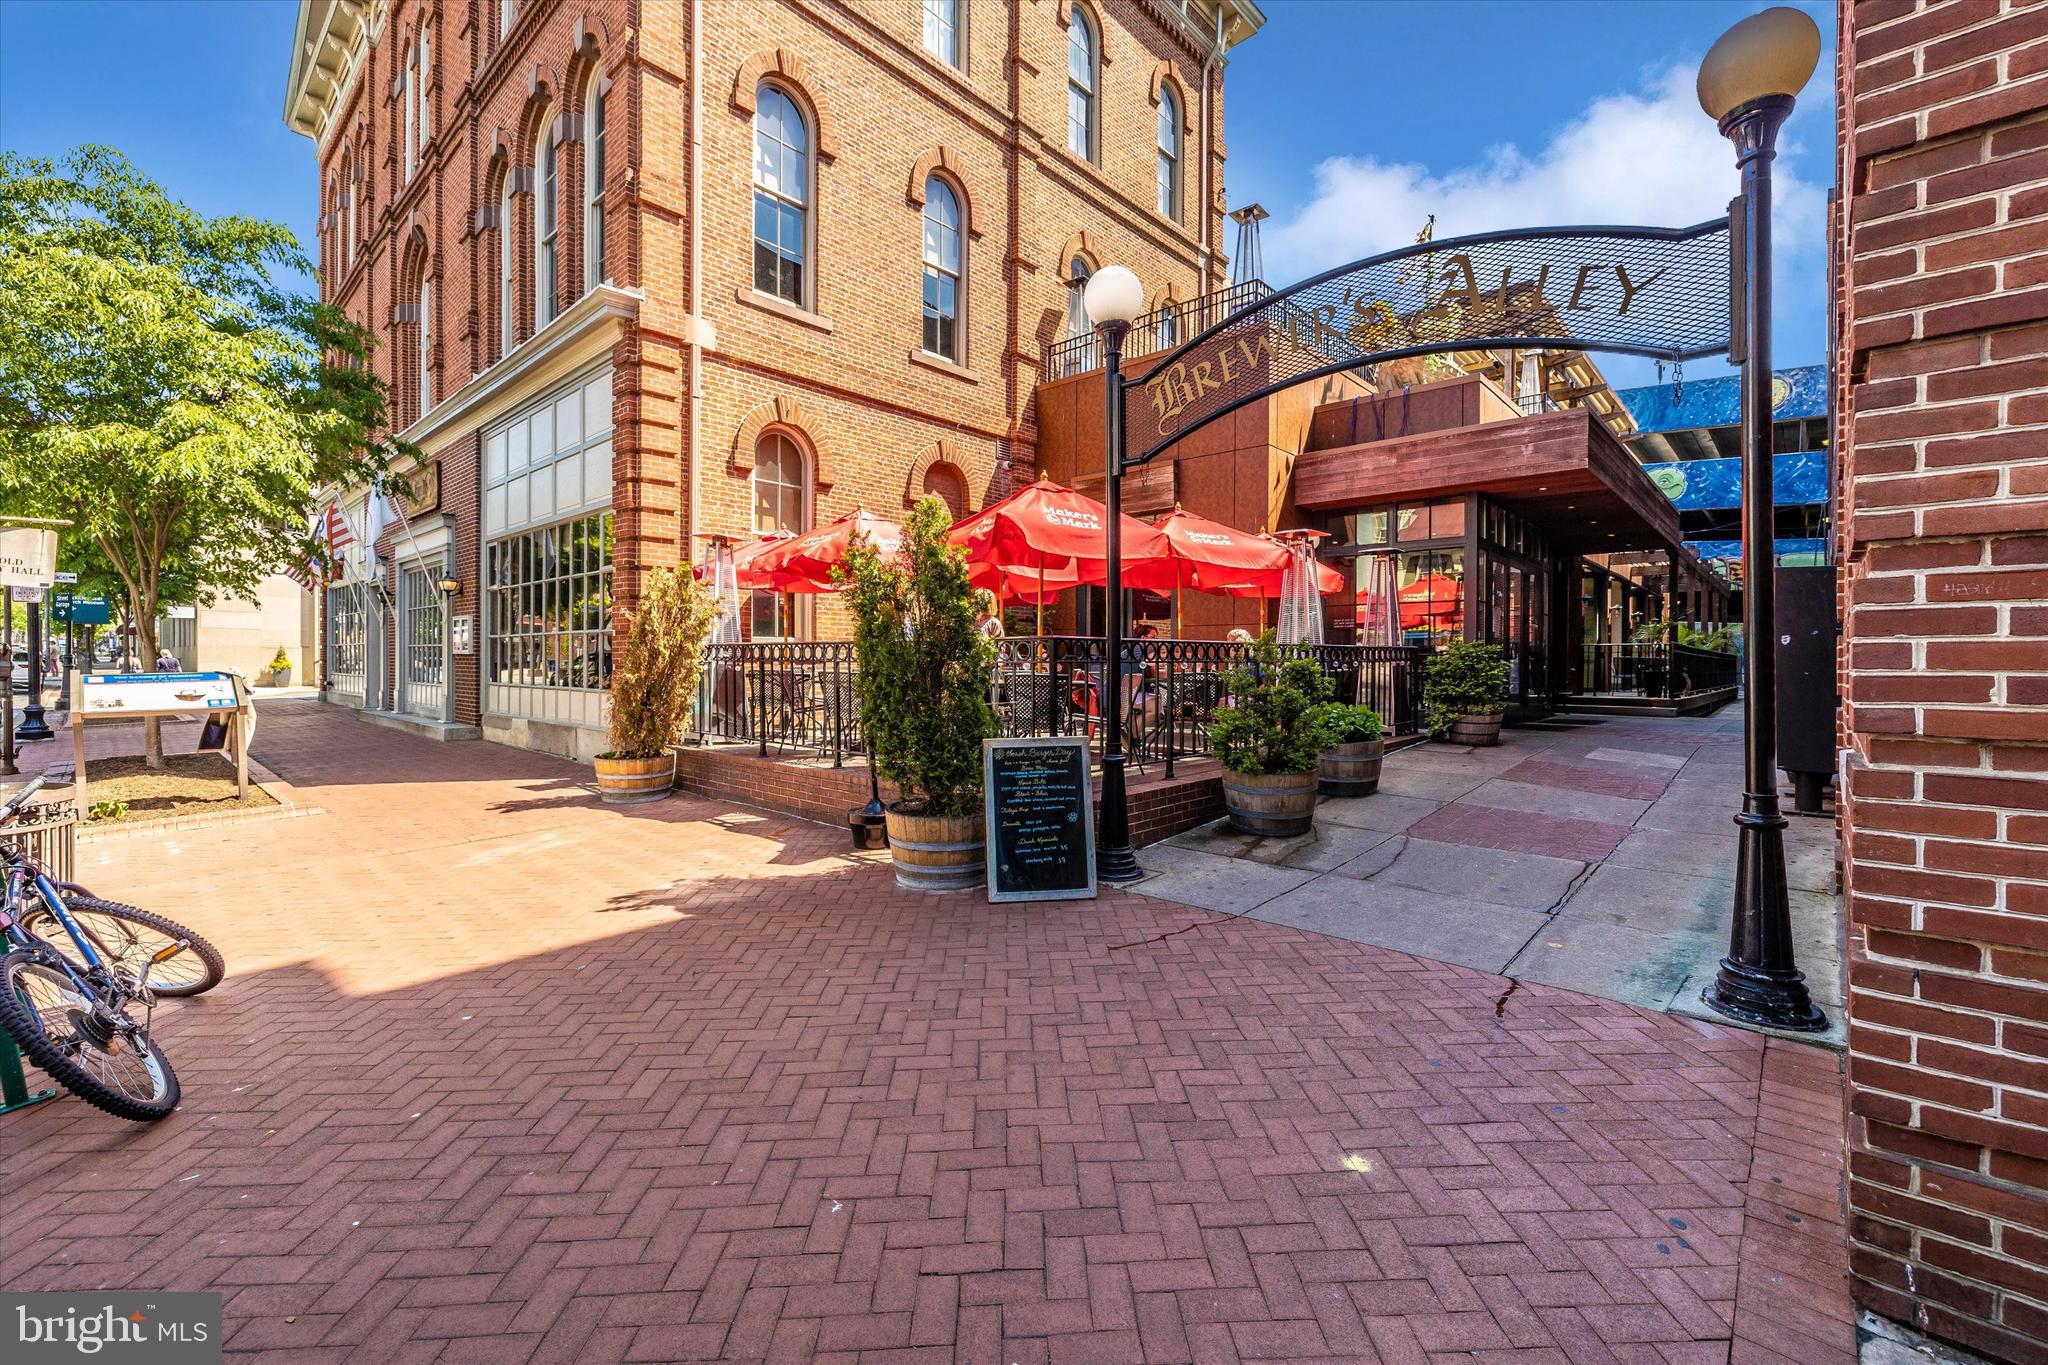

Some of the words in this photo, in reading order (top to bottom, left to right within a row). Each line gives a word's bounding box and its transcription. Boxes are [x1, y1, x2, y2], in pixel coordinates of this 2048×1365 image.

[1411, 252, 1666, 338] ALLEY
[1041, 504, 1099, 522] Maker's
[0, 557, 23, 566] OLD
[11, 566, 44, 576] HALL
